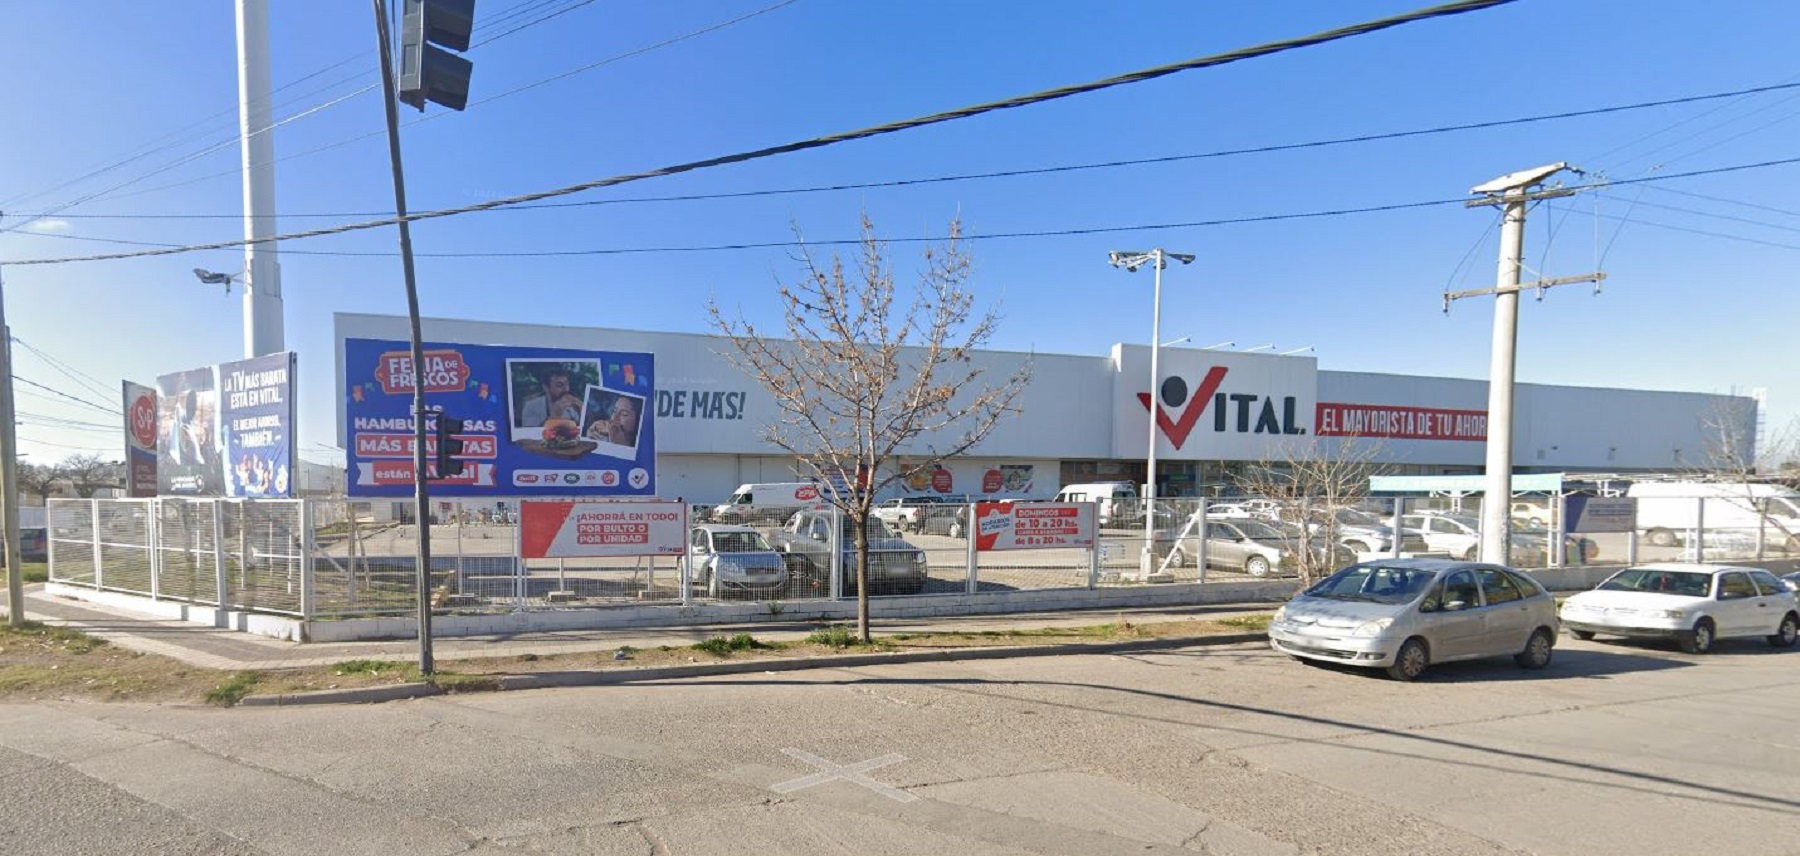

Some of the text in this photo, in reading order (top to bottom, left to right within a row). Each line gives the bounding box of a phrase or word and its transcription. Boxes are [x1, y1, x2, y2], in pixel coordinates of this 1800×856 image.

[389, 356, 444, 373] FEIA
[232, 370, 245, 392] TV
[261, 368, 287, 387] BARATA
[249, 390, 259, 407] EN
[655, 390, 746, 420] DE MÁS!
[1323, 408, 1339, 432] EL
[1342, 409, 1414, 435] MAYORISTA
[1417, 413, 1432, 435] DE
[1436, 413, 1451, 436] TU
[360, 436, 492, 453] MÁS BATAS
[375, 467, 411, 478] están
[629, 512, 643, 521] EN
[1018, 509, 1059, 517] DOMINGOS
[580, 524, 646, 533] POR BULTO O
[1015, 520, 1026, 528] de
[1029, 519, 1040, 527] 10
[1050, 519, 1063, 527] 20
[579, 534, 643, 543] POR UNIDAD
[1015, 537, 1025, 545] de
[1028, 536, 1034, 544] 8
[1043, 536, 1054, 544] 20
